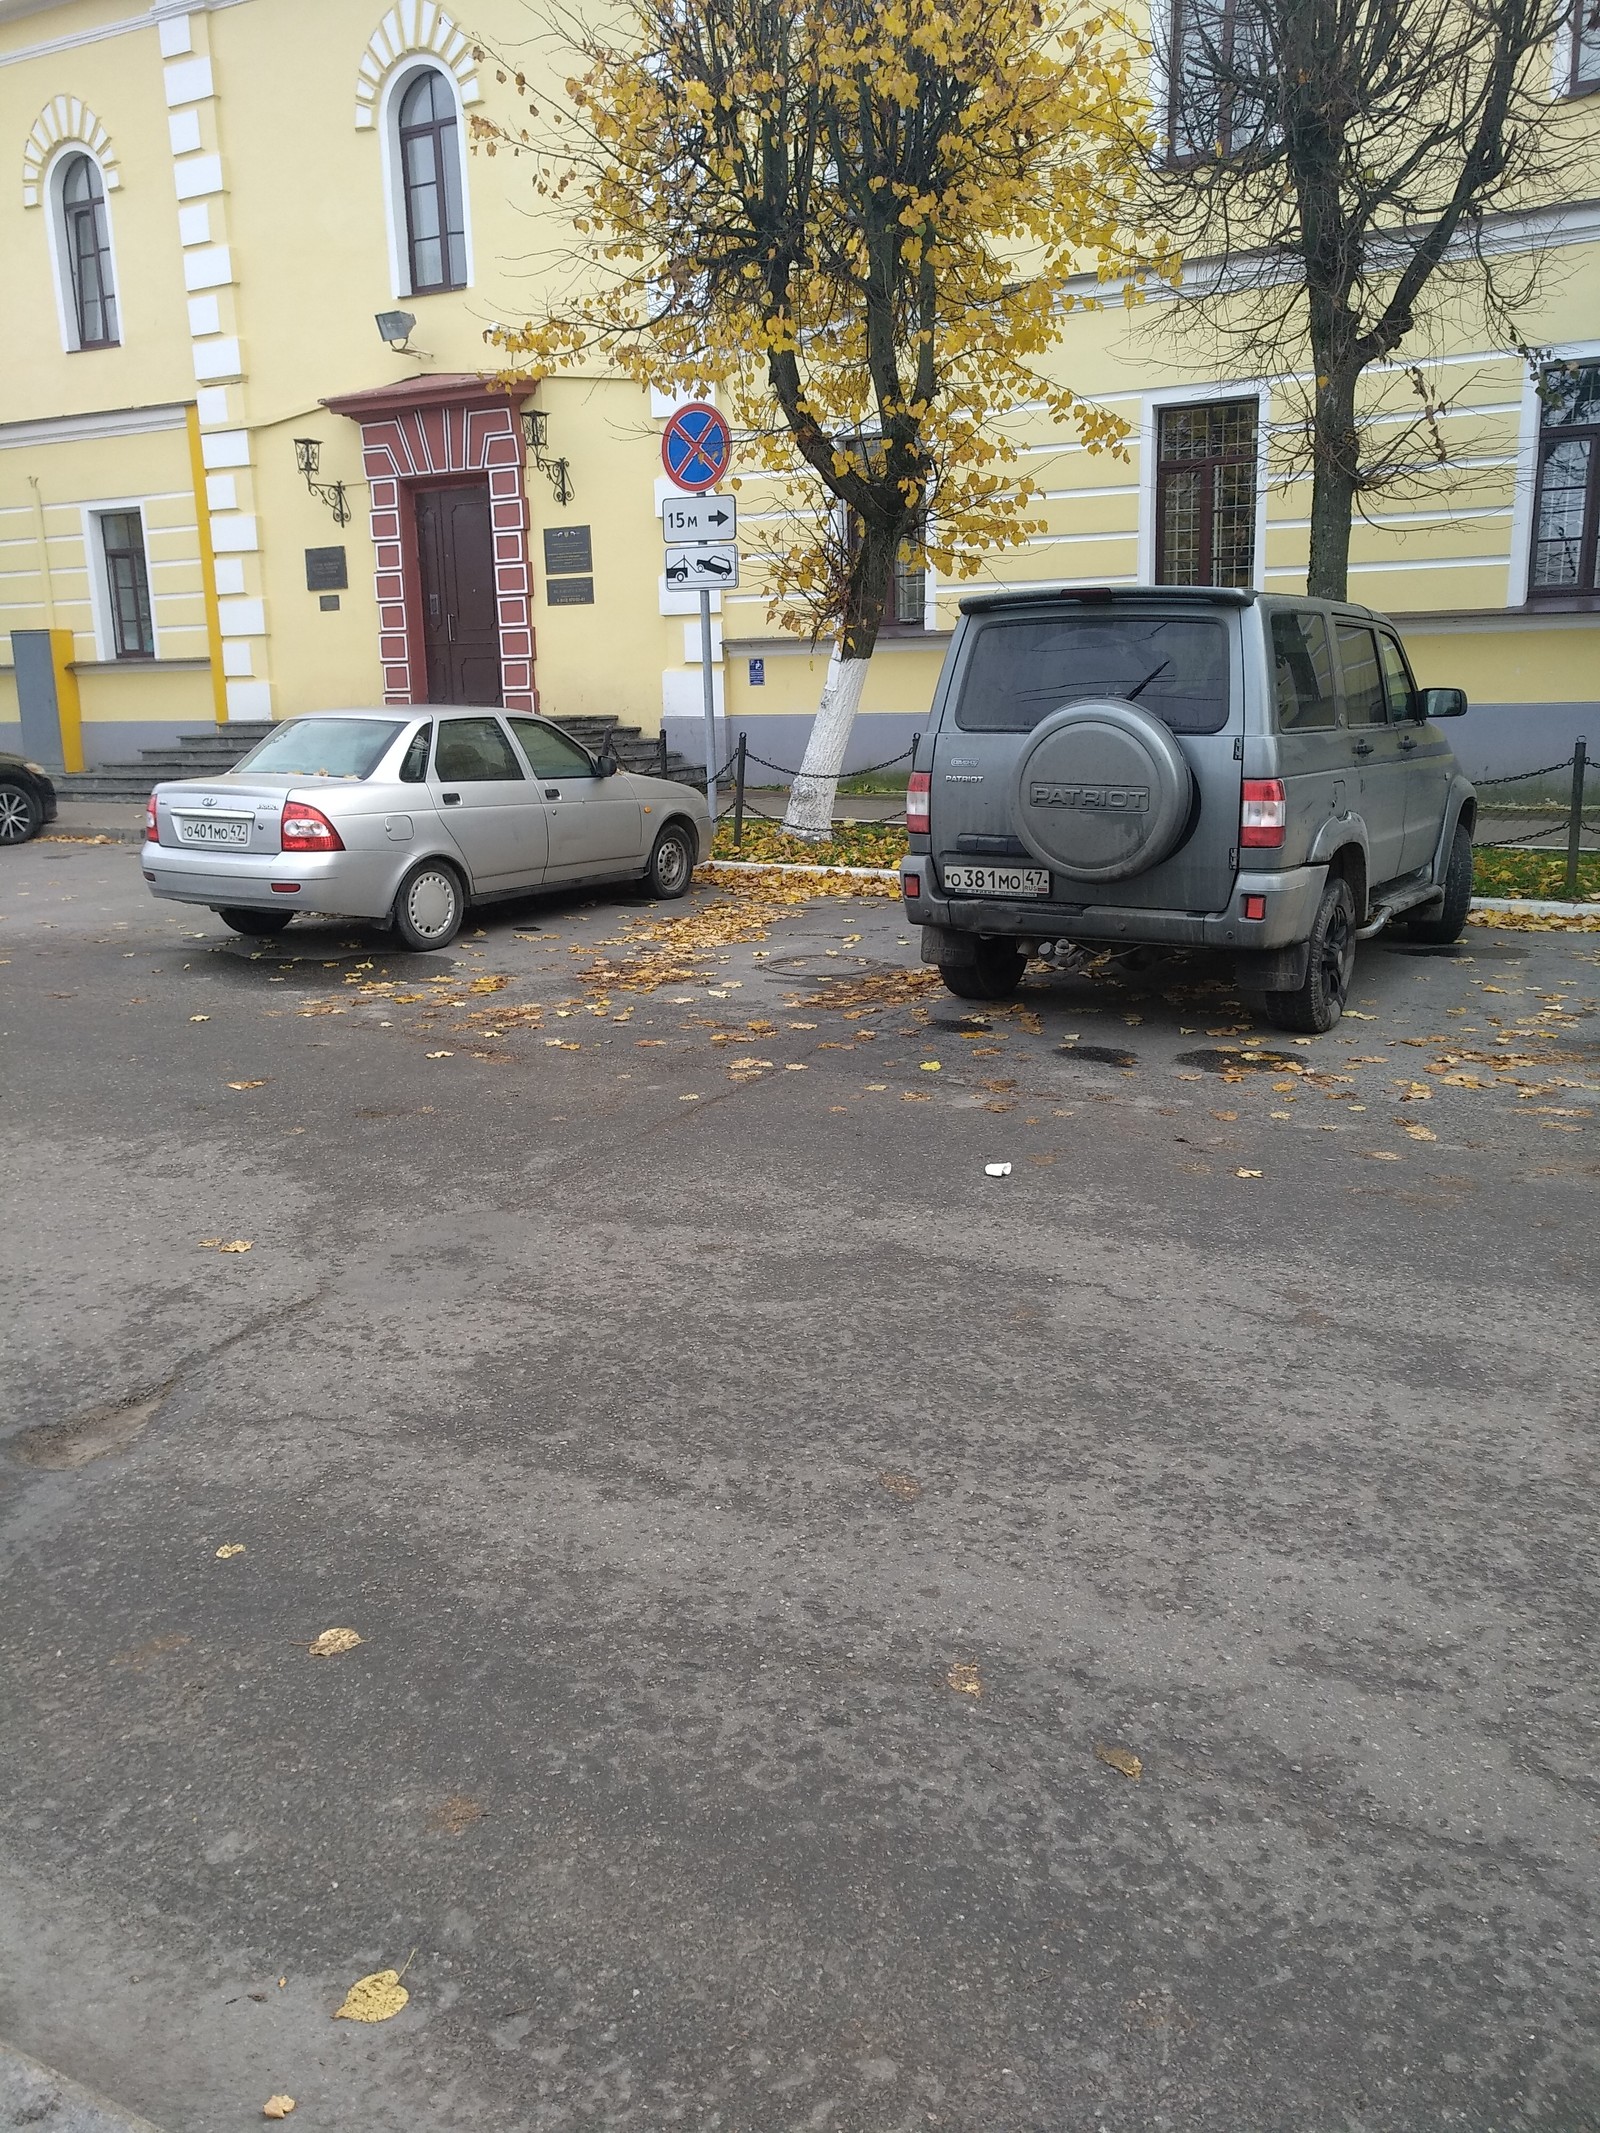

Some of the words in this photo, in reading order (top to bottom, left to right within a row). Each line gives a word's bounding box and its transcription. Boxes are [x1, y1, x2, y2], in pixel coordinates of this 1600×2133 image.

[945, 775, 984, 783] PATRIOT
[1033, 787, 1147, 808] PATRIOT
[231, 825, 243, 837] 47
[1025, 871, 1043, 886] 47
